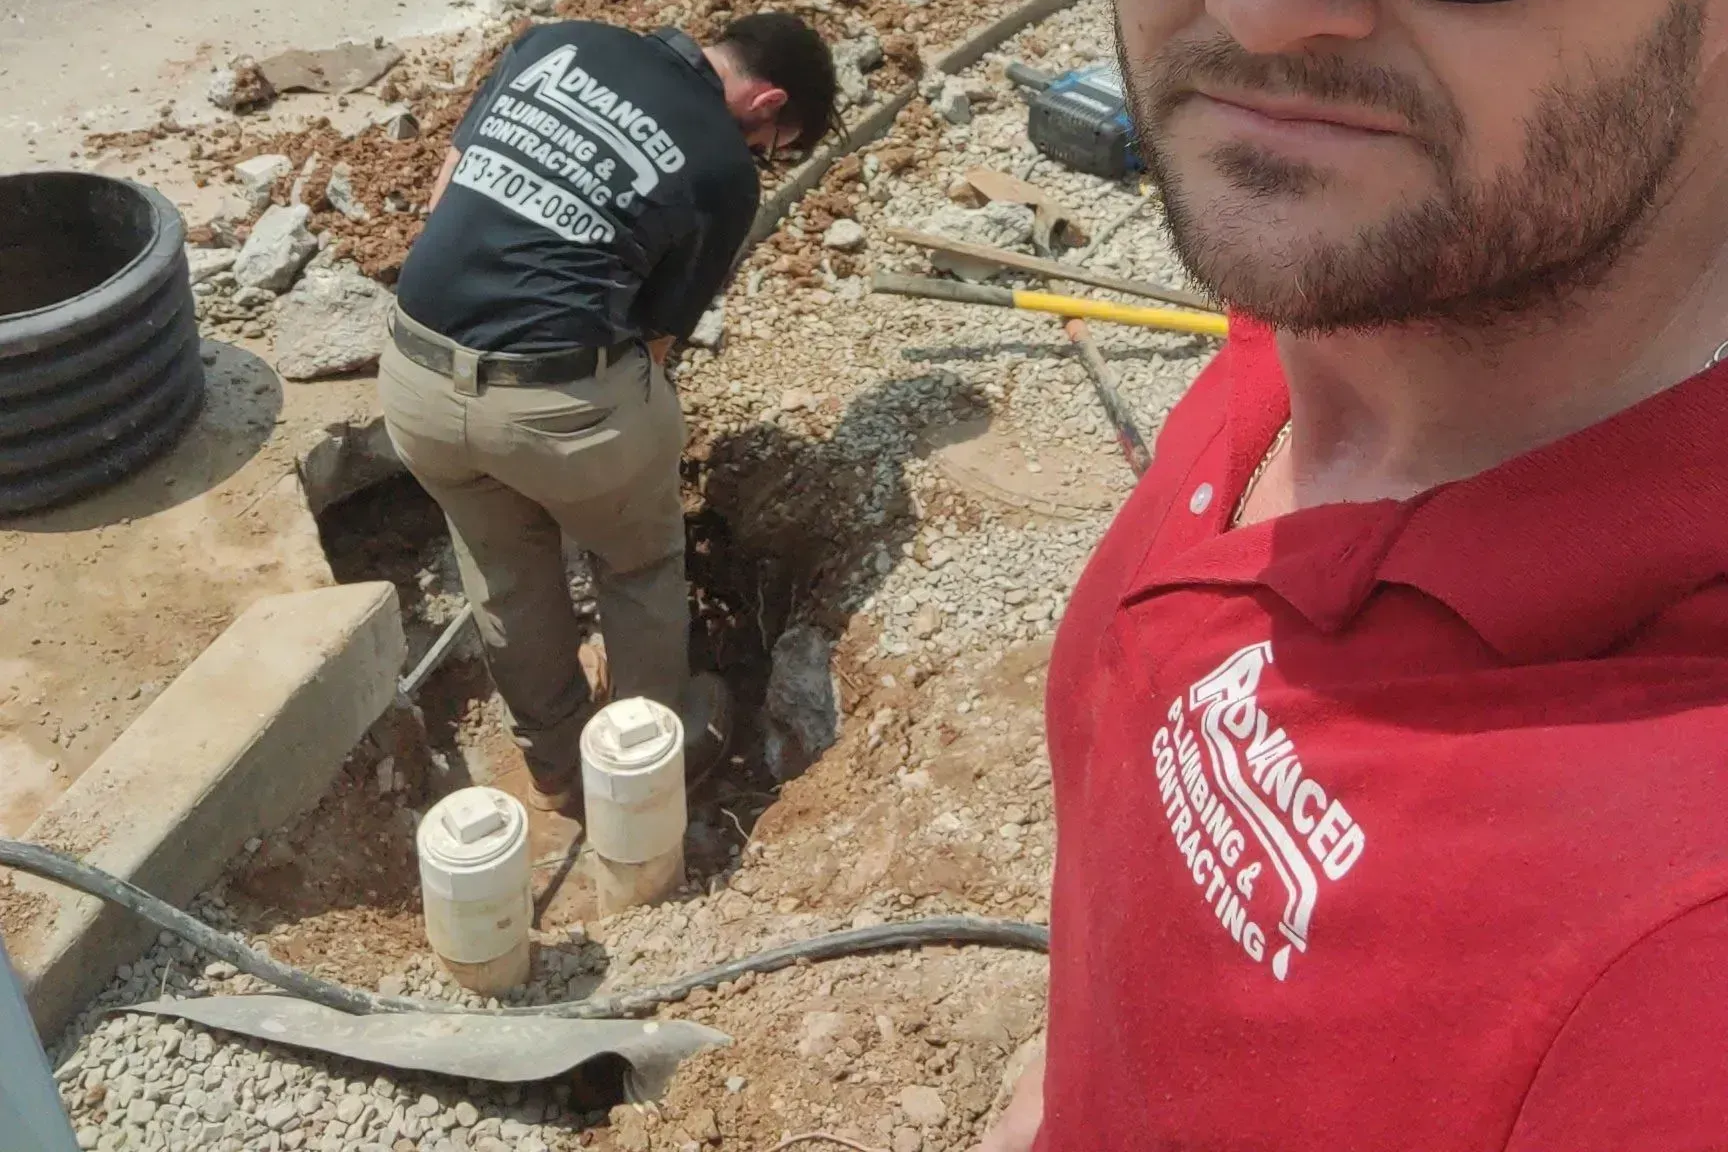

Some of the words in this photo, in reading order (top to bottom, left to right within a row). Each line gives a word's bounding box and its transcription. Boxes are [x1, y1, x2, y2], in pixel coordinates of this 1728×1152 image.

[479, 116, 613, 207] CONTRACTING
[491, 94, 597, 162] PLUMBING
[594, 158, 617, 181] &
[509, 43, 686, 174] ADVANCED
[458, 151, 608, 243] 53-707-0800
[1167, 696, 1245, 867] PLUMBING
[1236, 862, 1262, 901] &
[1189, 640, 1366, 882] ADVANCED
[1152, 727, 1266, 963] CONTRACTING
